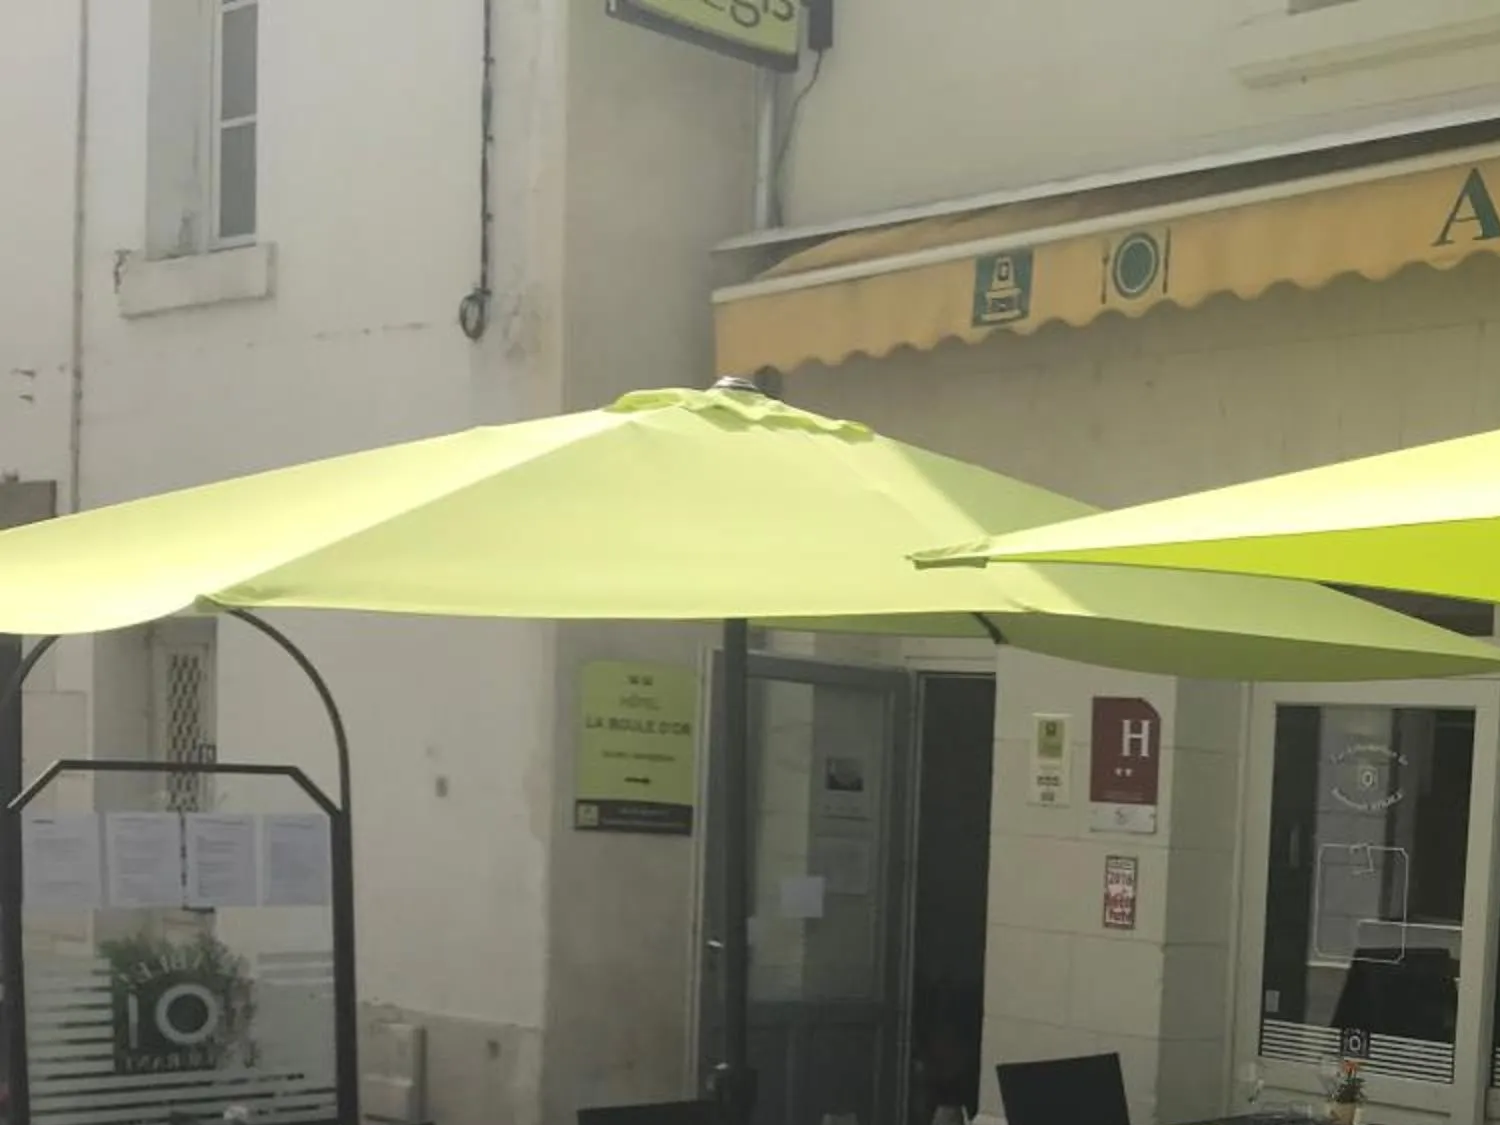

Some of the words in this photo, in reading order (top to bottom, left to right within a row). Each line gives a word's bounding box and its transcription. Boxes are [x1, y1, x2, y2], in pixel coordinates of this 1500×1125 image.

[585, 714, 603, 729] LA
[609, 717, 656, 734] BOULE
[1122, 719, 1151, 758] H
